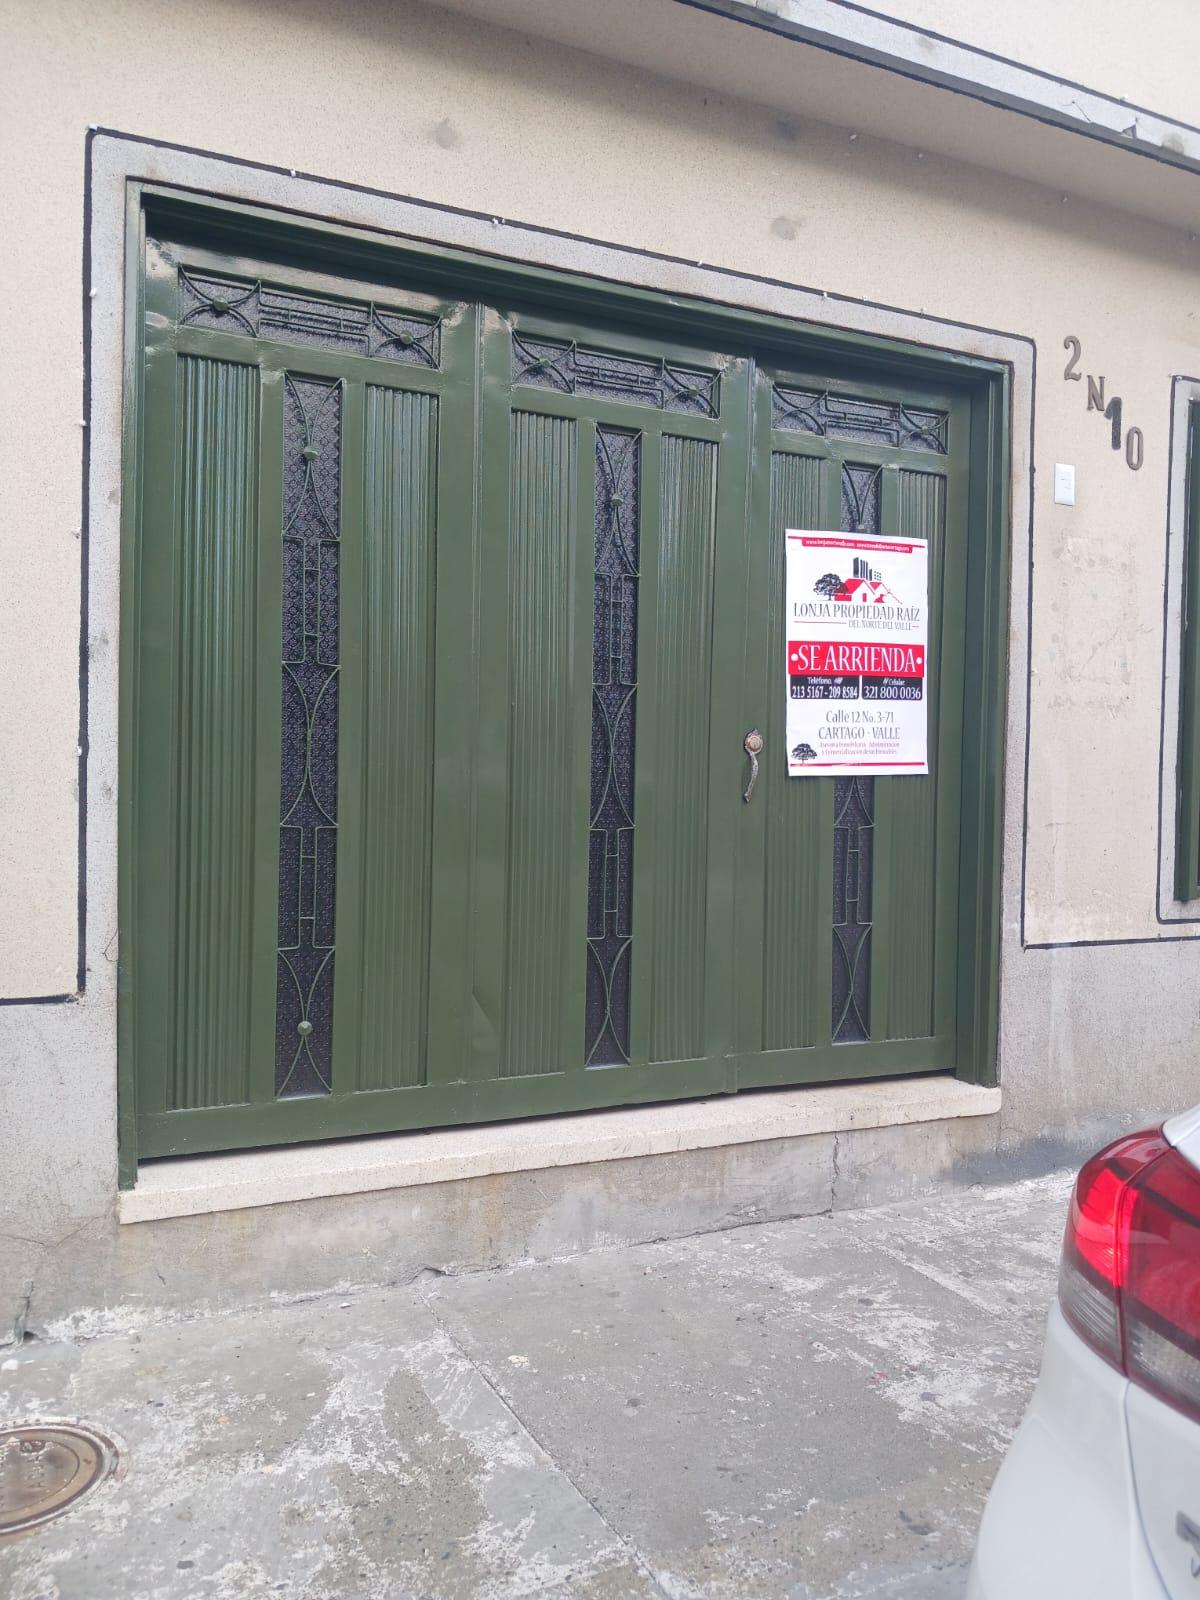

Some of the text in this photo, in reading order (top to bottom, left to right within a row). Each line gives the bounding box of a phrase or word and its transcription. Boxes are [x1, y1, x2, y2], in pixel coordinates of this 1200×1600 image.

[794, 602, 920, 622] LONJA PROPIEDAD RAÍZ
[797, 644, 916, 673] SE ARRIENDA
[792, 686, 805, 698] 213
[807, 686, 824, 698] 5167
[829, 686, 841, 698] 209
[842, 686, 858, 699] 8584
[864, 686, 921, 700] 321 800 0036
[826, 710, 850, 723] Calle
[851, 711, 860, 723] 12
[877, 711, 894, 723] 3-71
[818, 727, 865, 740] CARTAGO
[872, 728, 901, 740] VALLE
